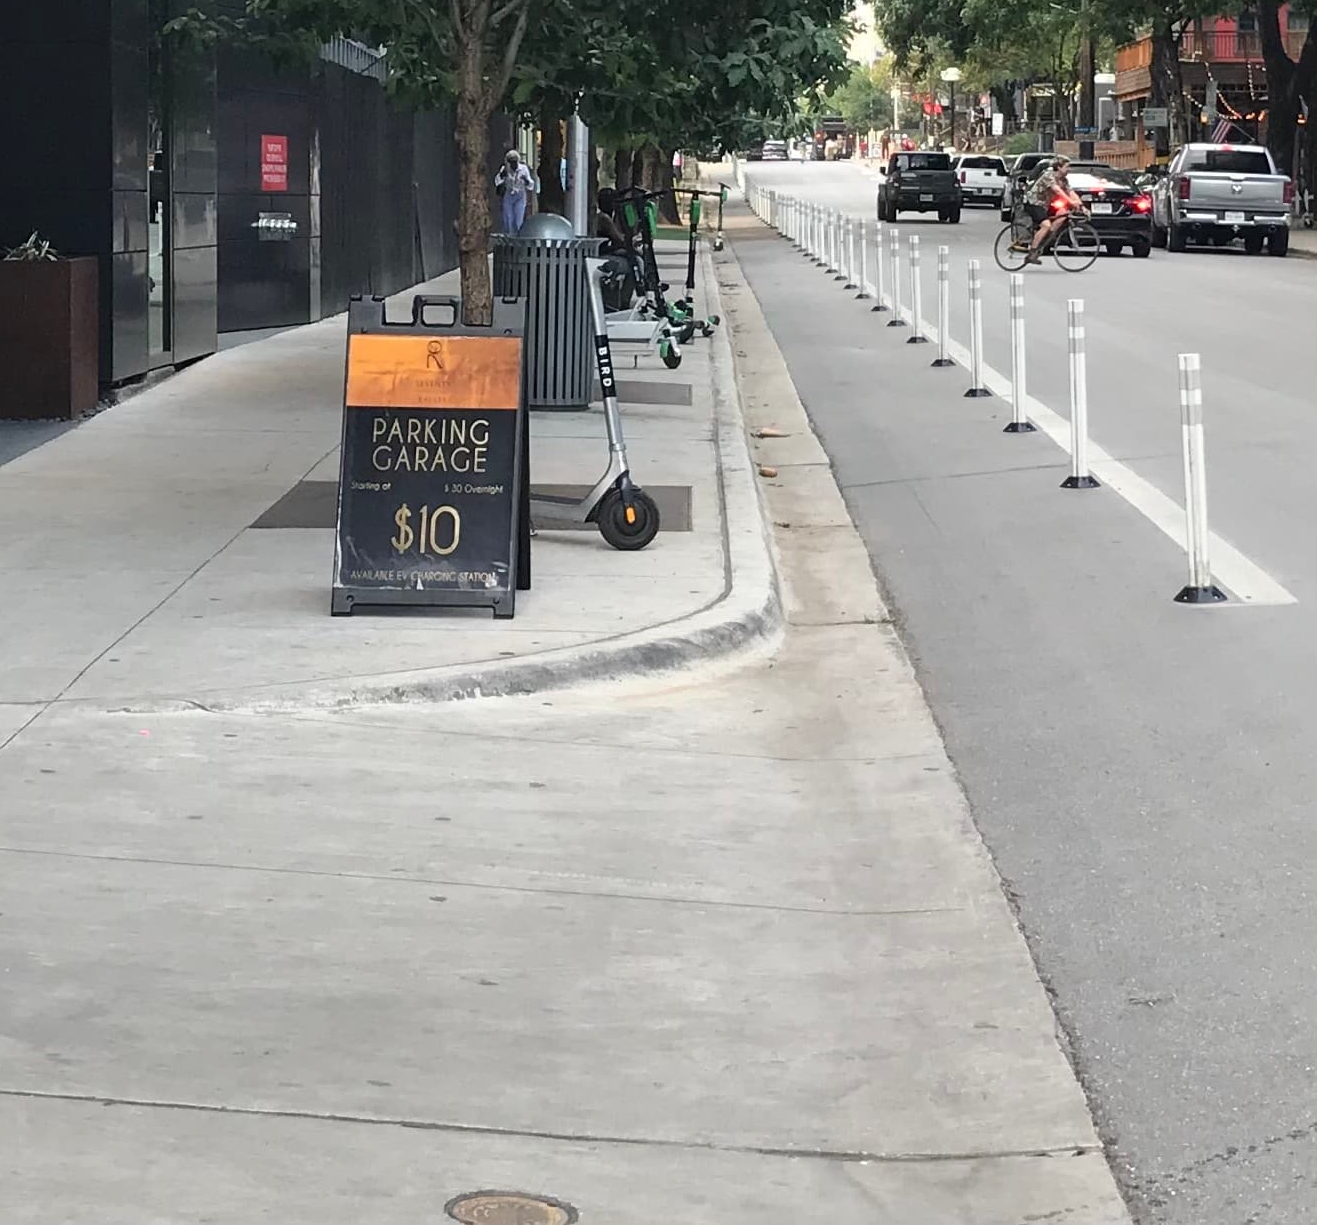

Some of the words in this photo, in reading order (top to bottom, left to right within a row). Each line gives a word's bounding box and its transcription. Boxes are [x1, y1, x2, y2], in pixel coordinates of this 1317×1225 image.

[597, 346, 612, 387] BIRD
[372, 418, 490, 445] PARKING
[372, 446, 488, 473] GARAGE
[465, 484, 504, 495] Overnight
[391, 503, 461, 555] $10
[350, 570, 394, 581] AVAILABLE
[411, 570, 456, 582] CHARGING
